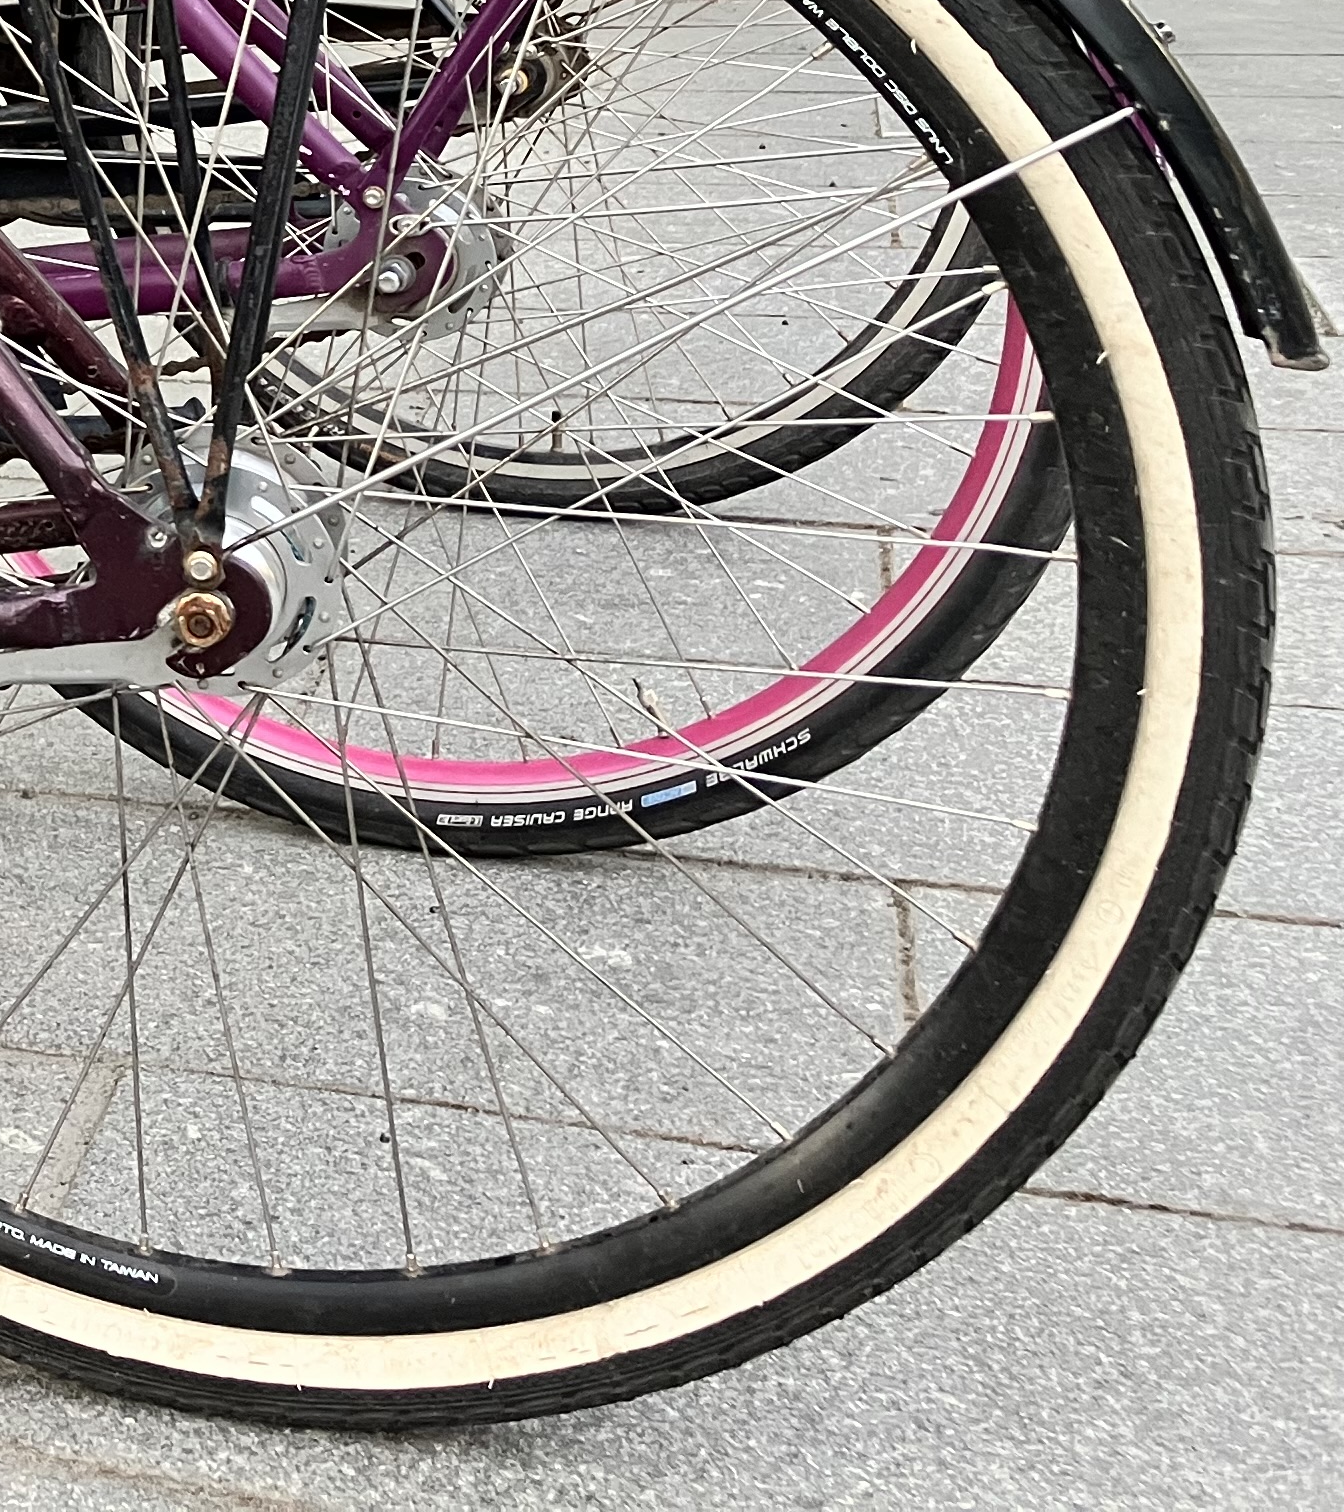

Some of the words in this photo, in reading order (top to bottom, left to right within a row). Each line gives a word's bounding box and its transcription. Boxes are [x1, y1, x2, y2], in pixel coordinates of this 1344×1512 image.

[825, 18, 886, 78] DOUBLE
[884, 79, 918, 115] DISC
[915, 118, 953, 164] LINUS
[490, 811, 566, 827] CRUISER
[29, 1234, 77, 1260] MADE
[79, 1252, 96, 1267] IN
[100, 1258, 160, 1284] TAIWAN
